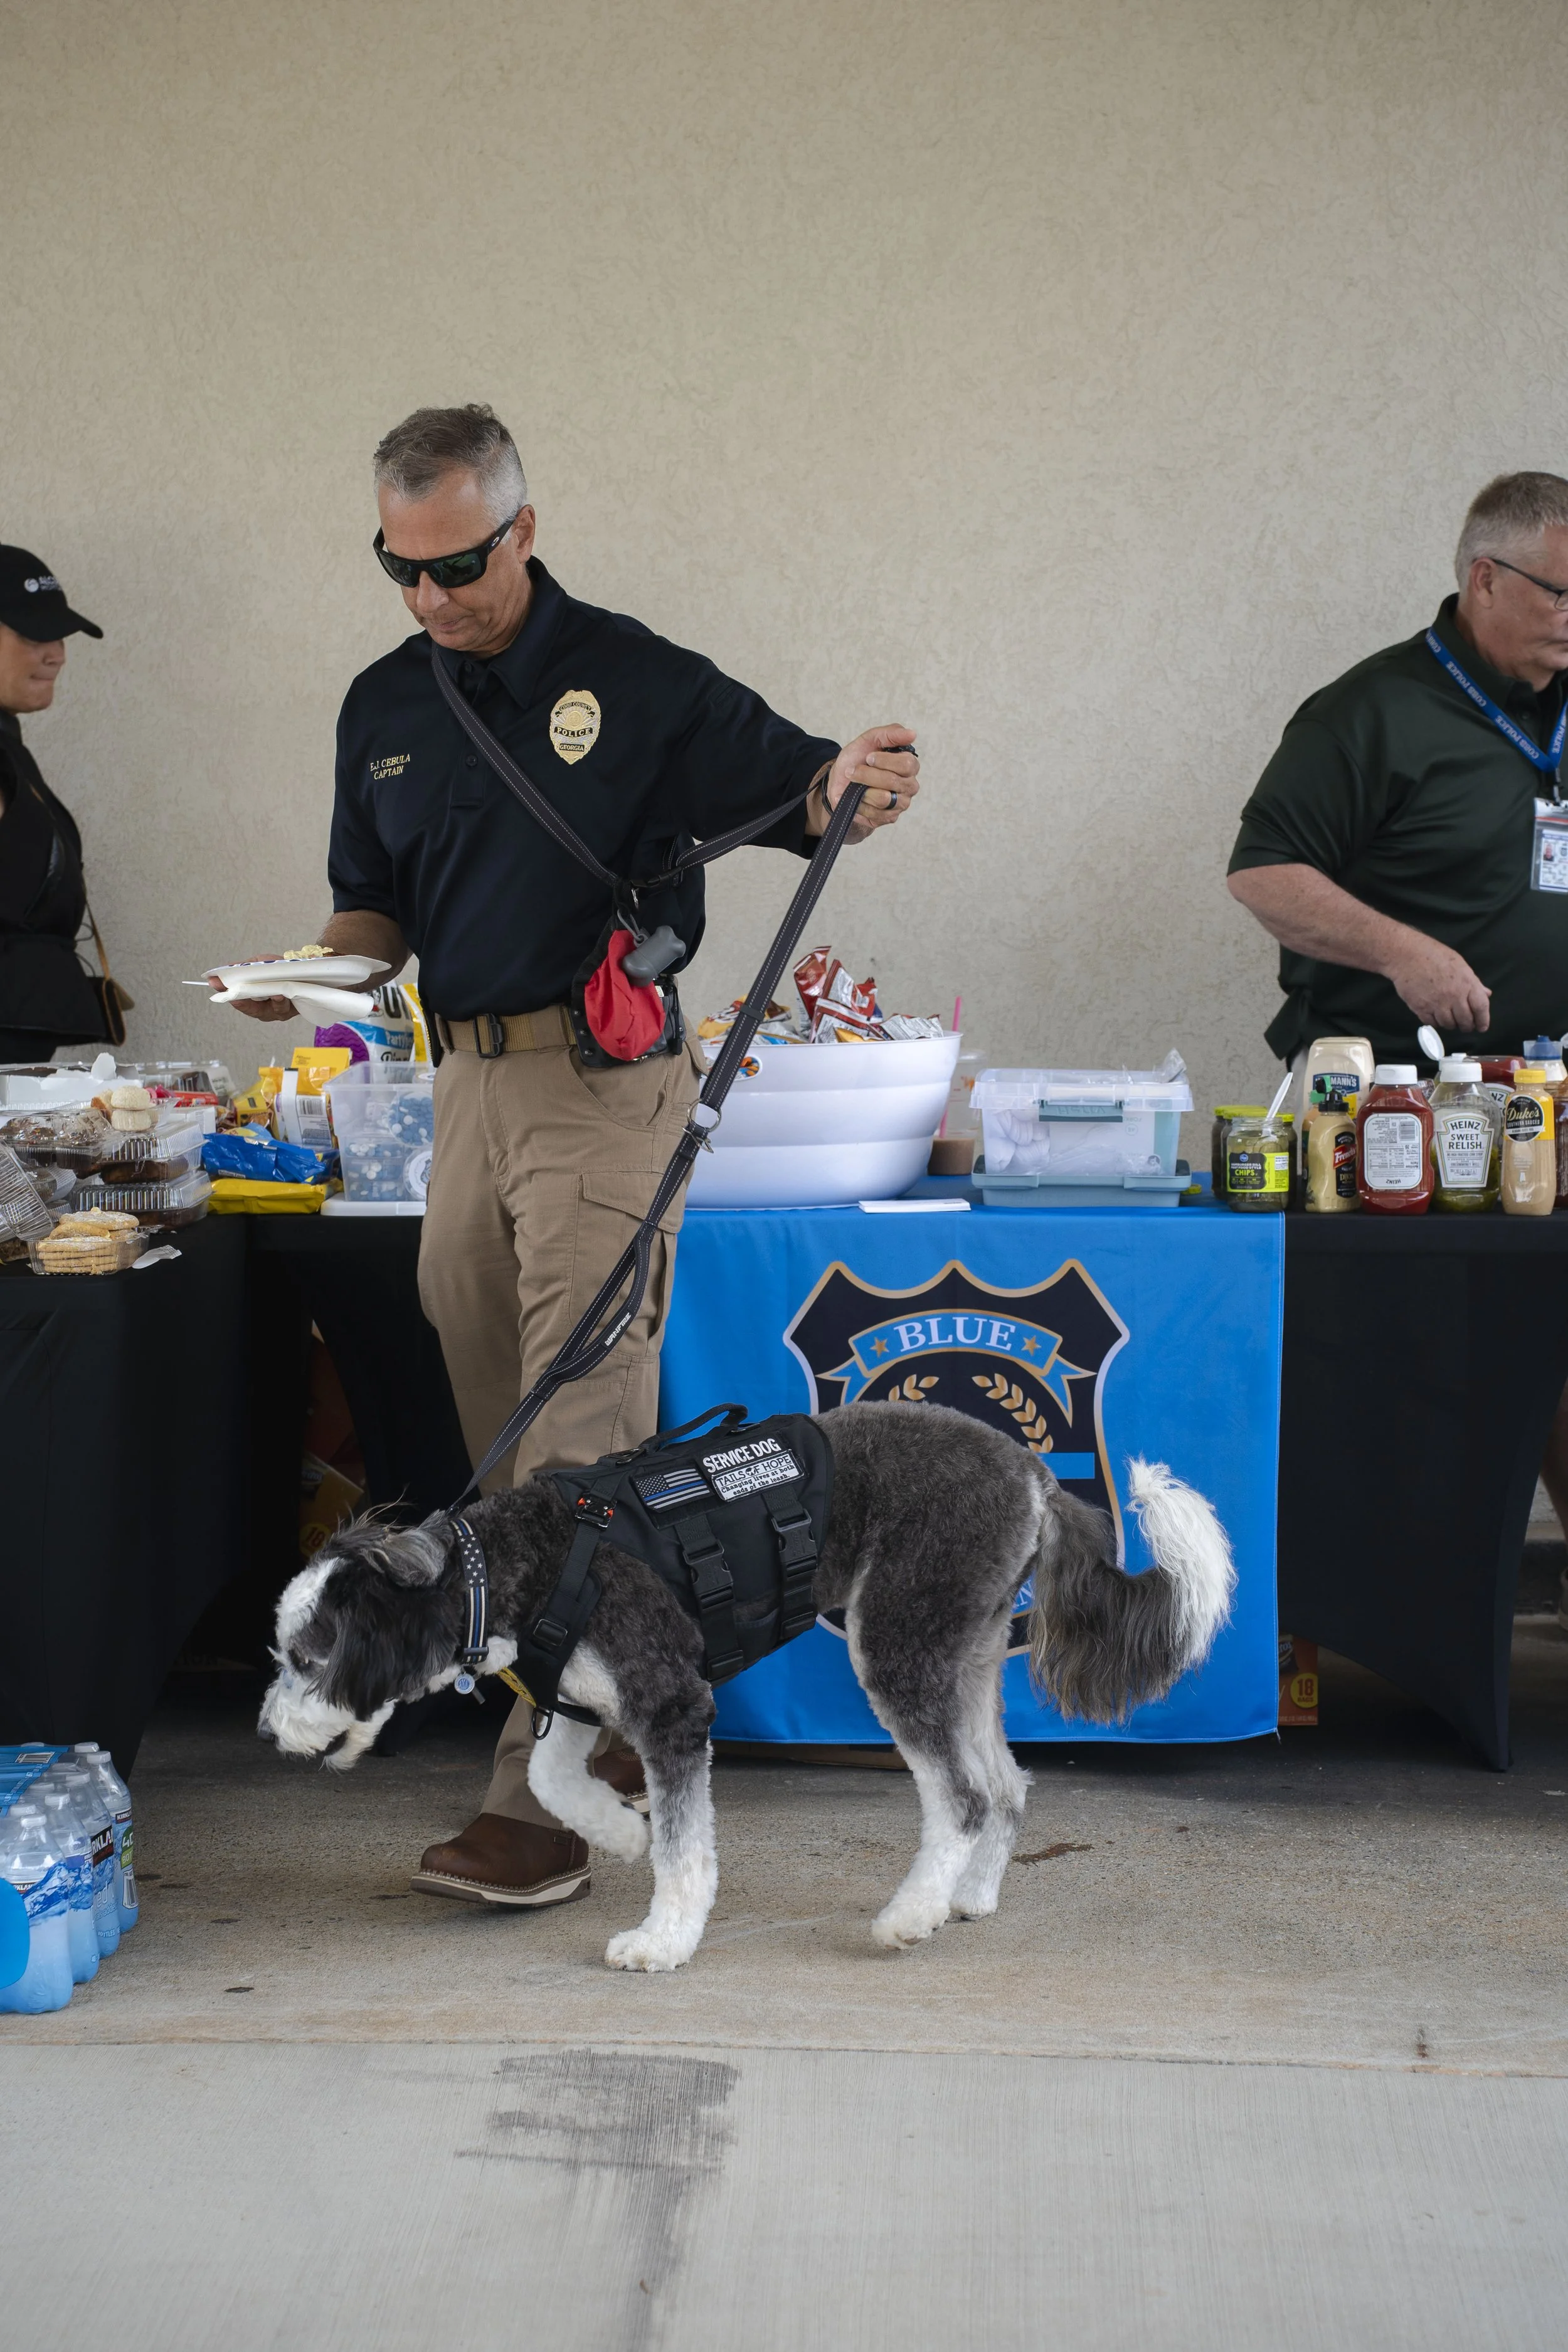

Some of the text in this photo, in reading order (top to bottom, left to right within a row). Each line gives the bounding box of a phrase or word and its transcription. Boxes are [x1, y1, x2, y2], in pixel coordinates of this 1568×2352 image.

[1446, 661, 1470, 689] POLICE
[556, 728, 591, 738] POLICE
[1495, 715, 1539, 759] COBB POLICE
[381, 753, 411, 768] CEBULA
[374, 765, 404, 780] CAPTAIN
[1507, 1107, 1540, 1121] Duke's
[1450, 1121, 1481, 1130] HEINZ
[1448, 1142, 1482, 1150] RELISH
[893, 1316, 1016, 1352] BLUE
[703, 1438, 782, 1473] SERVICE DOG
[716, 1470, 746, 1486] TAILS
[761, 1454, 792, 1471] HOPE
[721, 1479, 753, 1493] Changing
[754, 1473, 770, 1483] lives
[780, 1465, 795, 1473] both
[733, 1487, 748, 1495] ends
[758, 1479, 770, 1487] the
[1297, 1678, 1314, 1697] 18
[92, 1828, 113, 1855] RKLA
